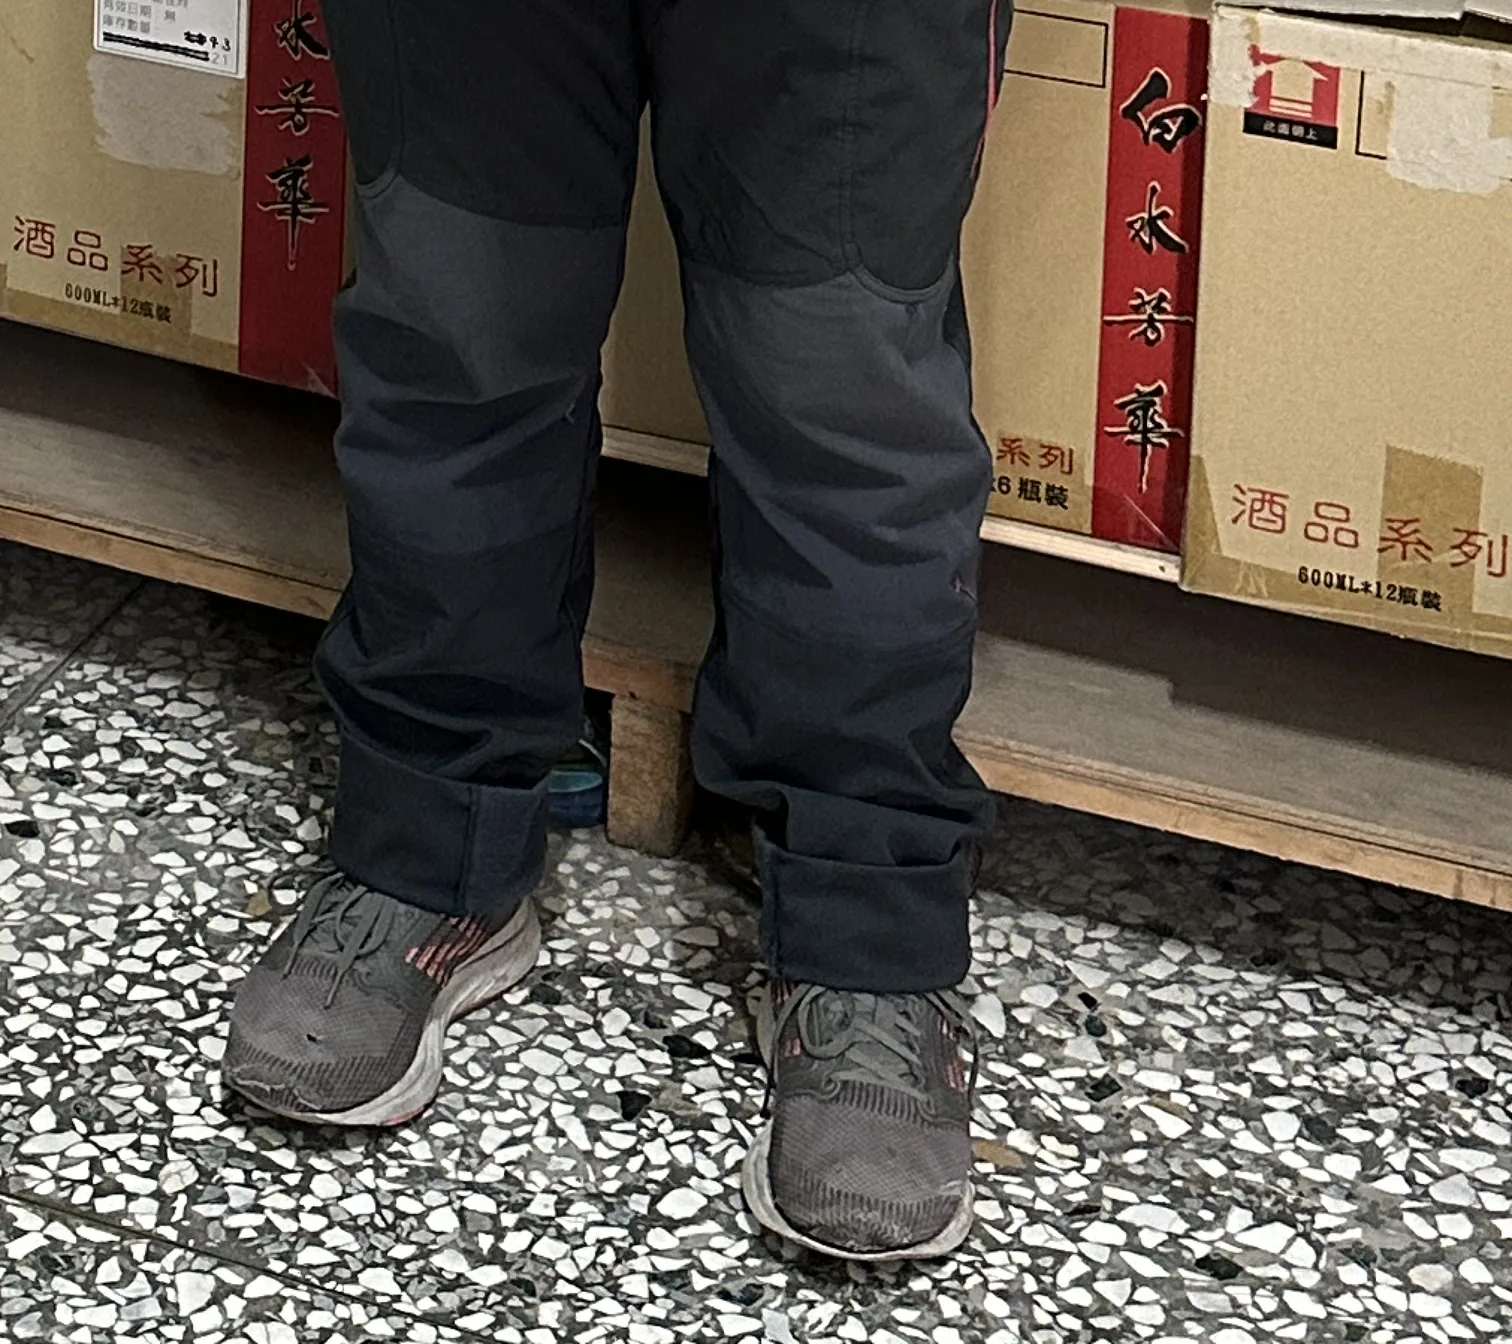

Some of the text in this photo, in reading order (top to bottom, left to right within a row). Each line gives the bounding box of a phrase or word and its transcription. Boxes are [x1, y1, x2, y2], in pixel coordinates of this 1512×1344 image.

[13, 213, 221, 299] 酒品系列
[996, 437, 1075, 476] 系列
[1231, 483, 1508, 579] 酒品系列
